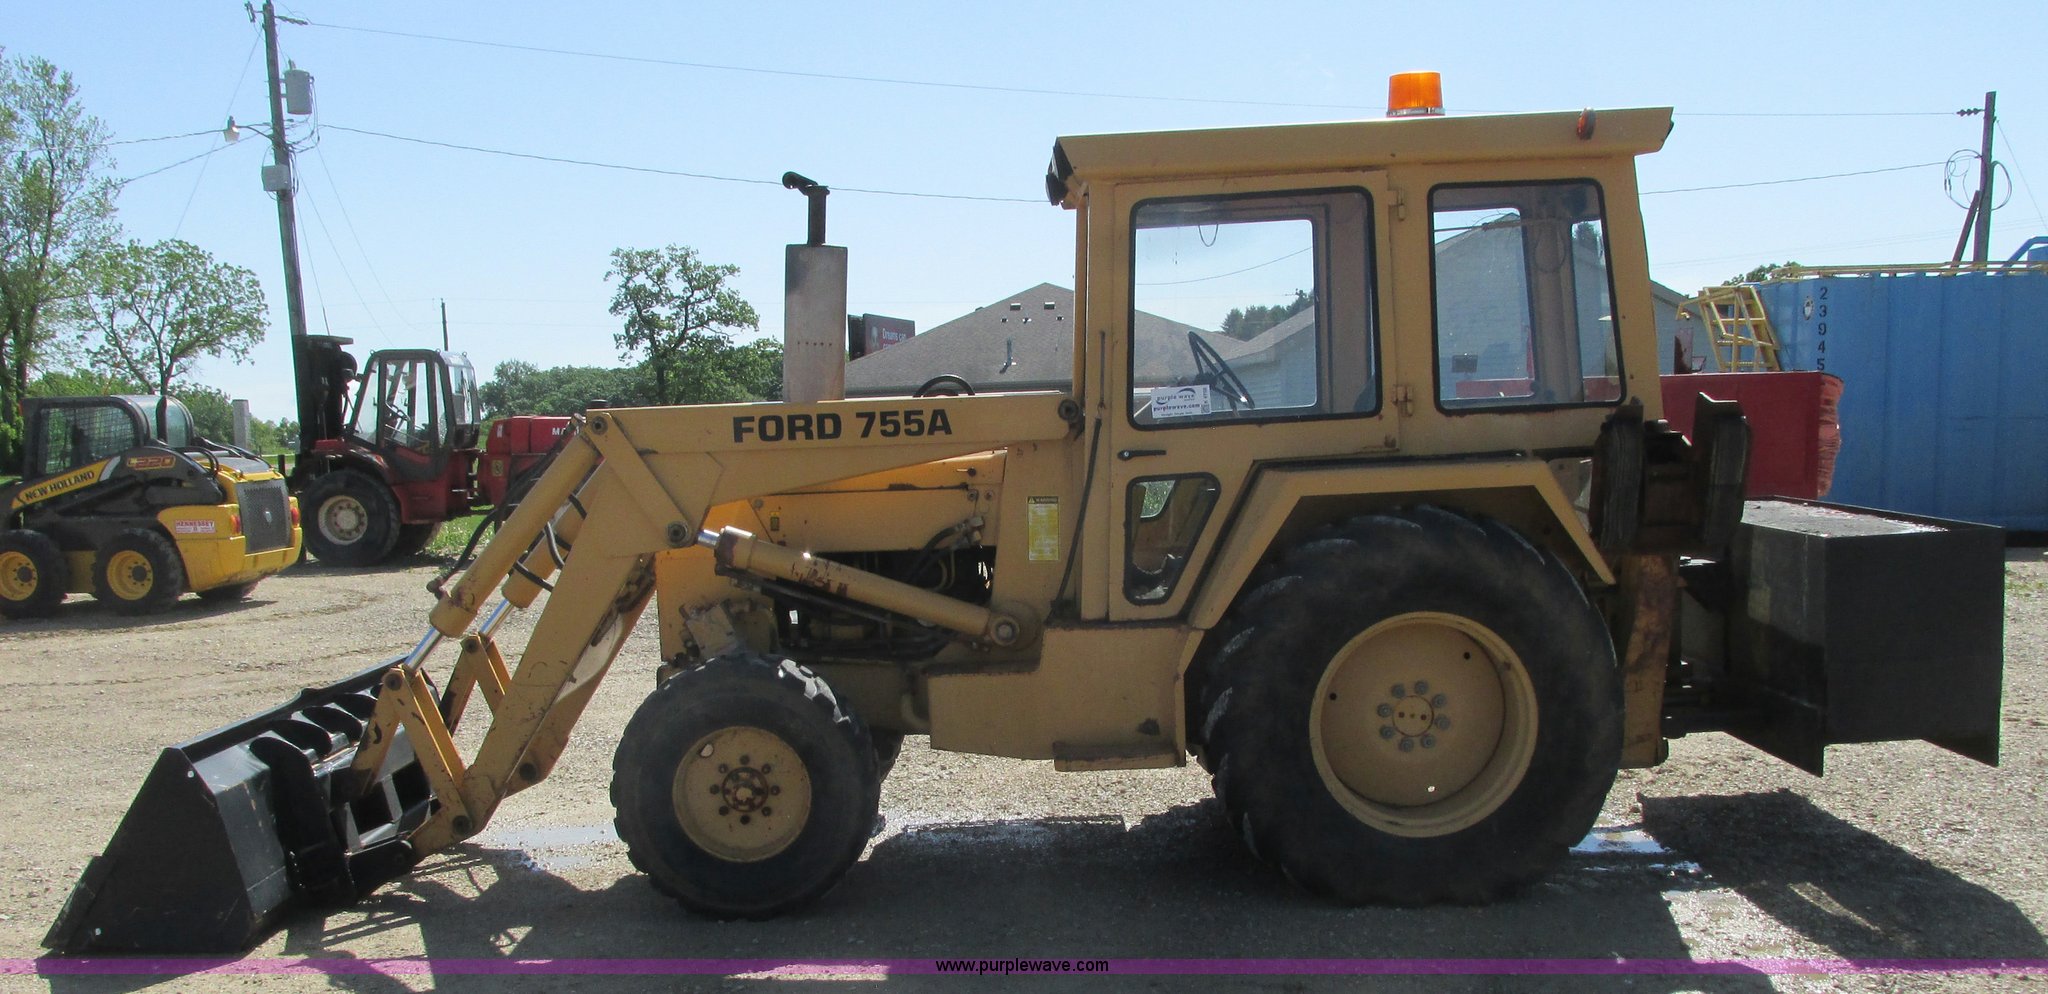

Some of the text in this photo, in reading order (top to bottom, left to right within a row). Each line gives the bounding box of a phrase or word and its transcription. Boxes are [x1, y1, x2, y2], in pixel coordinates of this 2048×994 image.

[1153, 403, 1201, 412] purplewave.com
[733, 409, 952, 443] FORD 755A
[24, 470, 95, 501] NEW HOLLAND
